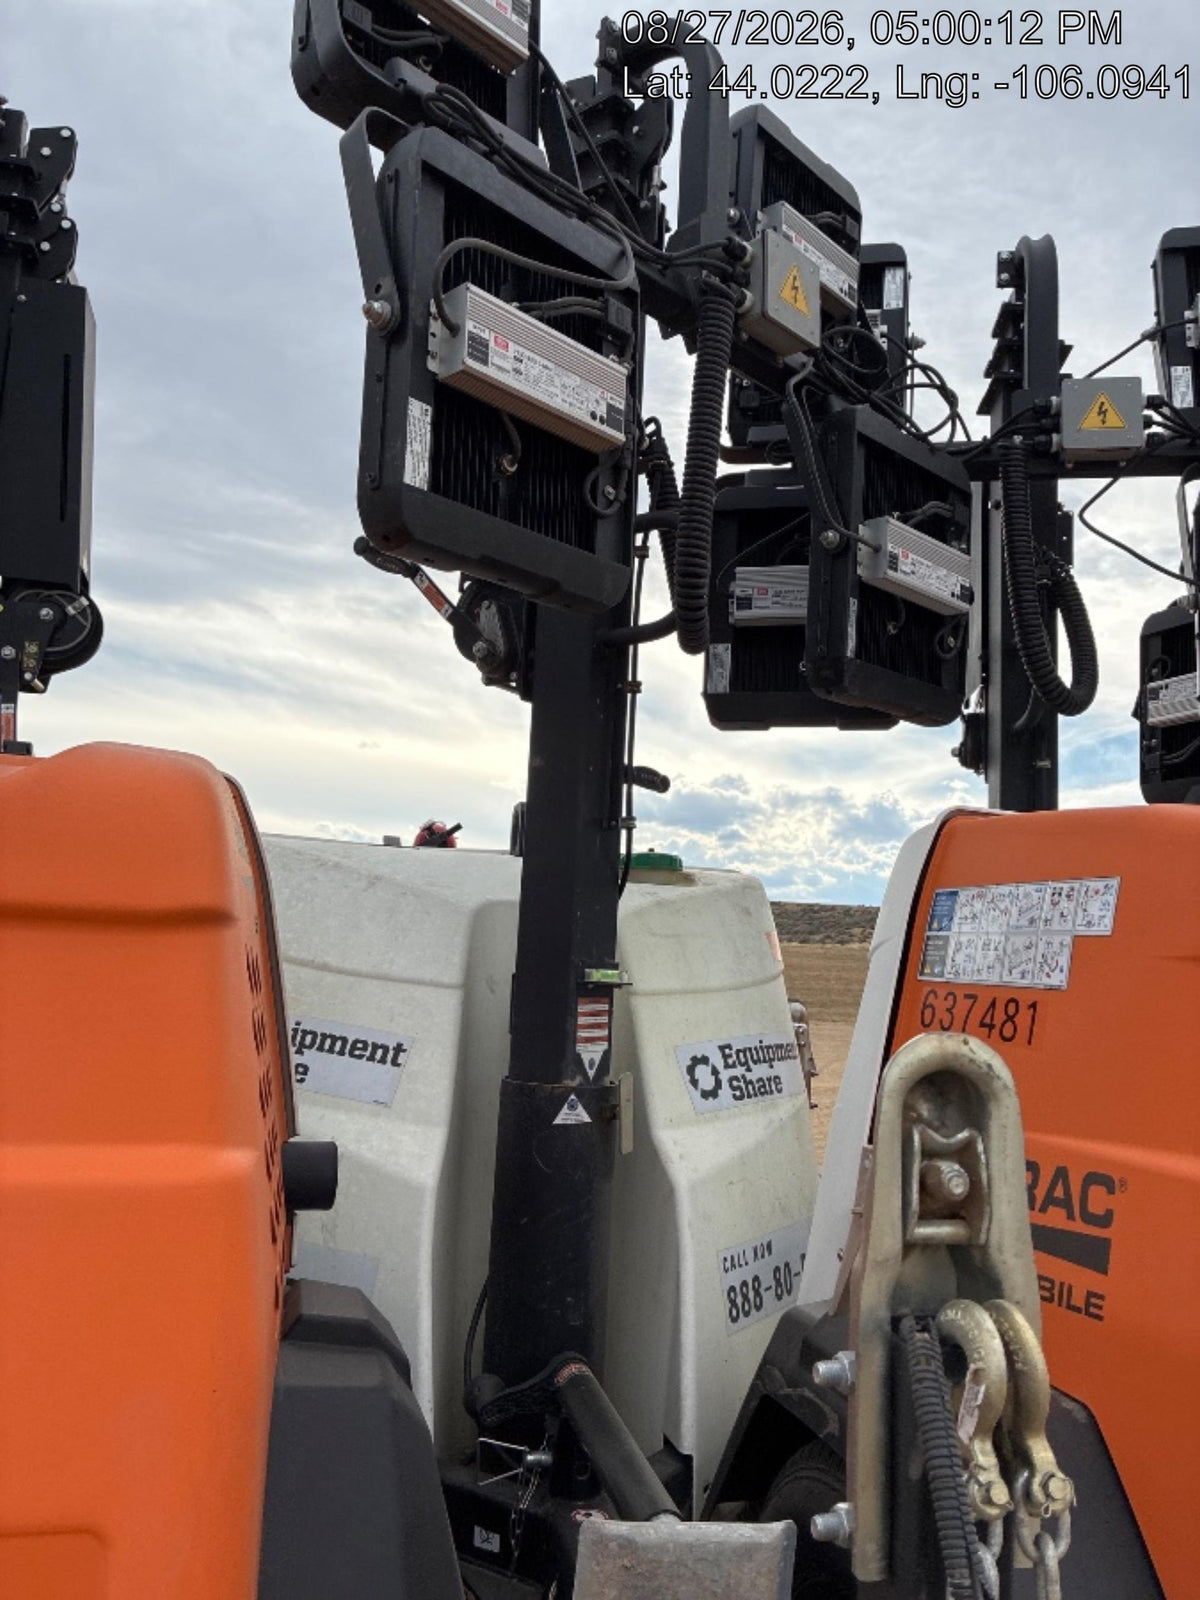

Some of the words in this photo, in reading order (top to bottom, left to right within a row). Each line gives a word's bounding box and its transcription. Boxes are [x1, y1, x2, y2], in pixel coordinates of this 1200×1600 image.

[920, 989, 1038, 1046] 637481
[727, 1073, 783, 1101] Share
[723, 1249, 749, 1273] CALL
